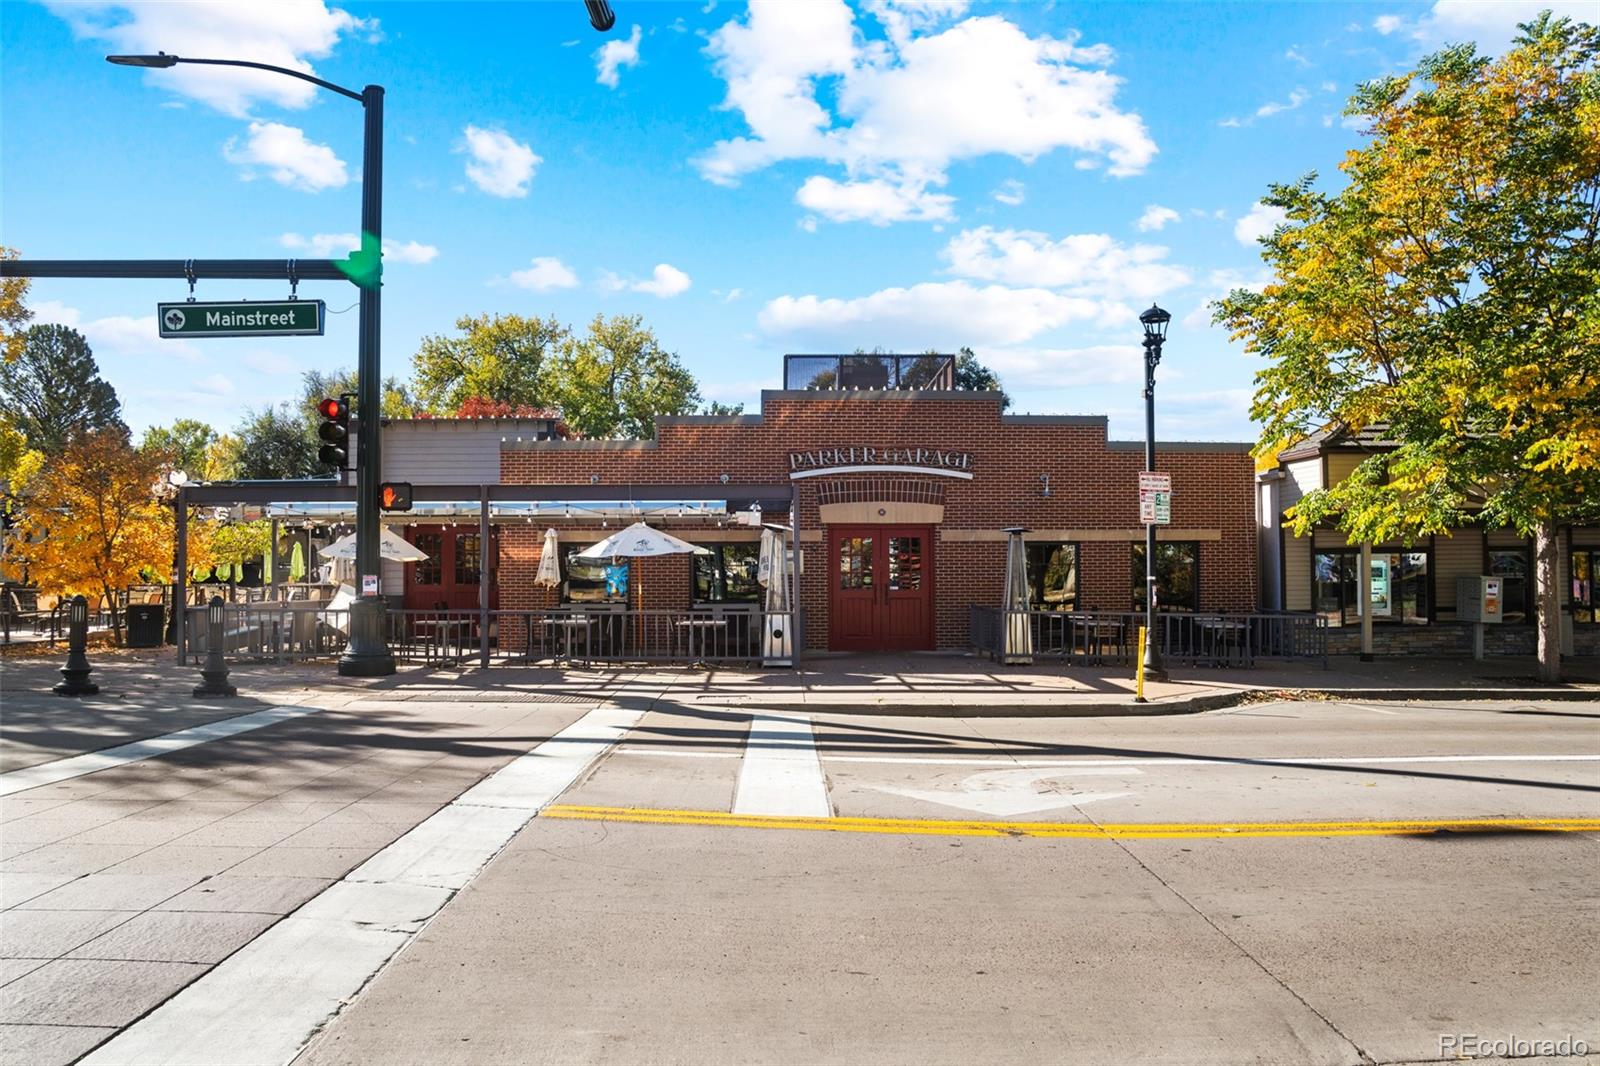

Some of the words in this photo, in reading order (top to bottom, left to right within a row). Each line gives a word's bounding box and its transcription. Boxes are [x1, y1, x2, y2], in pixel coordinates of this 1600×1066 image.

[206, 310, 295, 326] Mainstreet
[789, 447, 876, 469] PARKER
[883, 448, 975, 469] GARAGE
